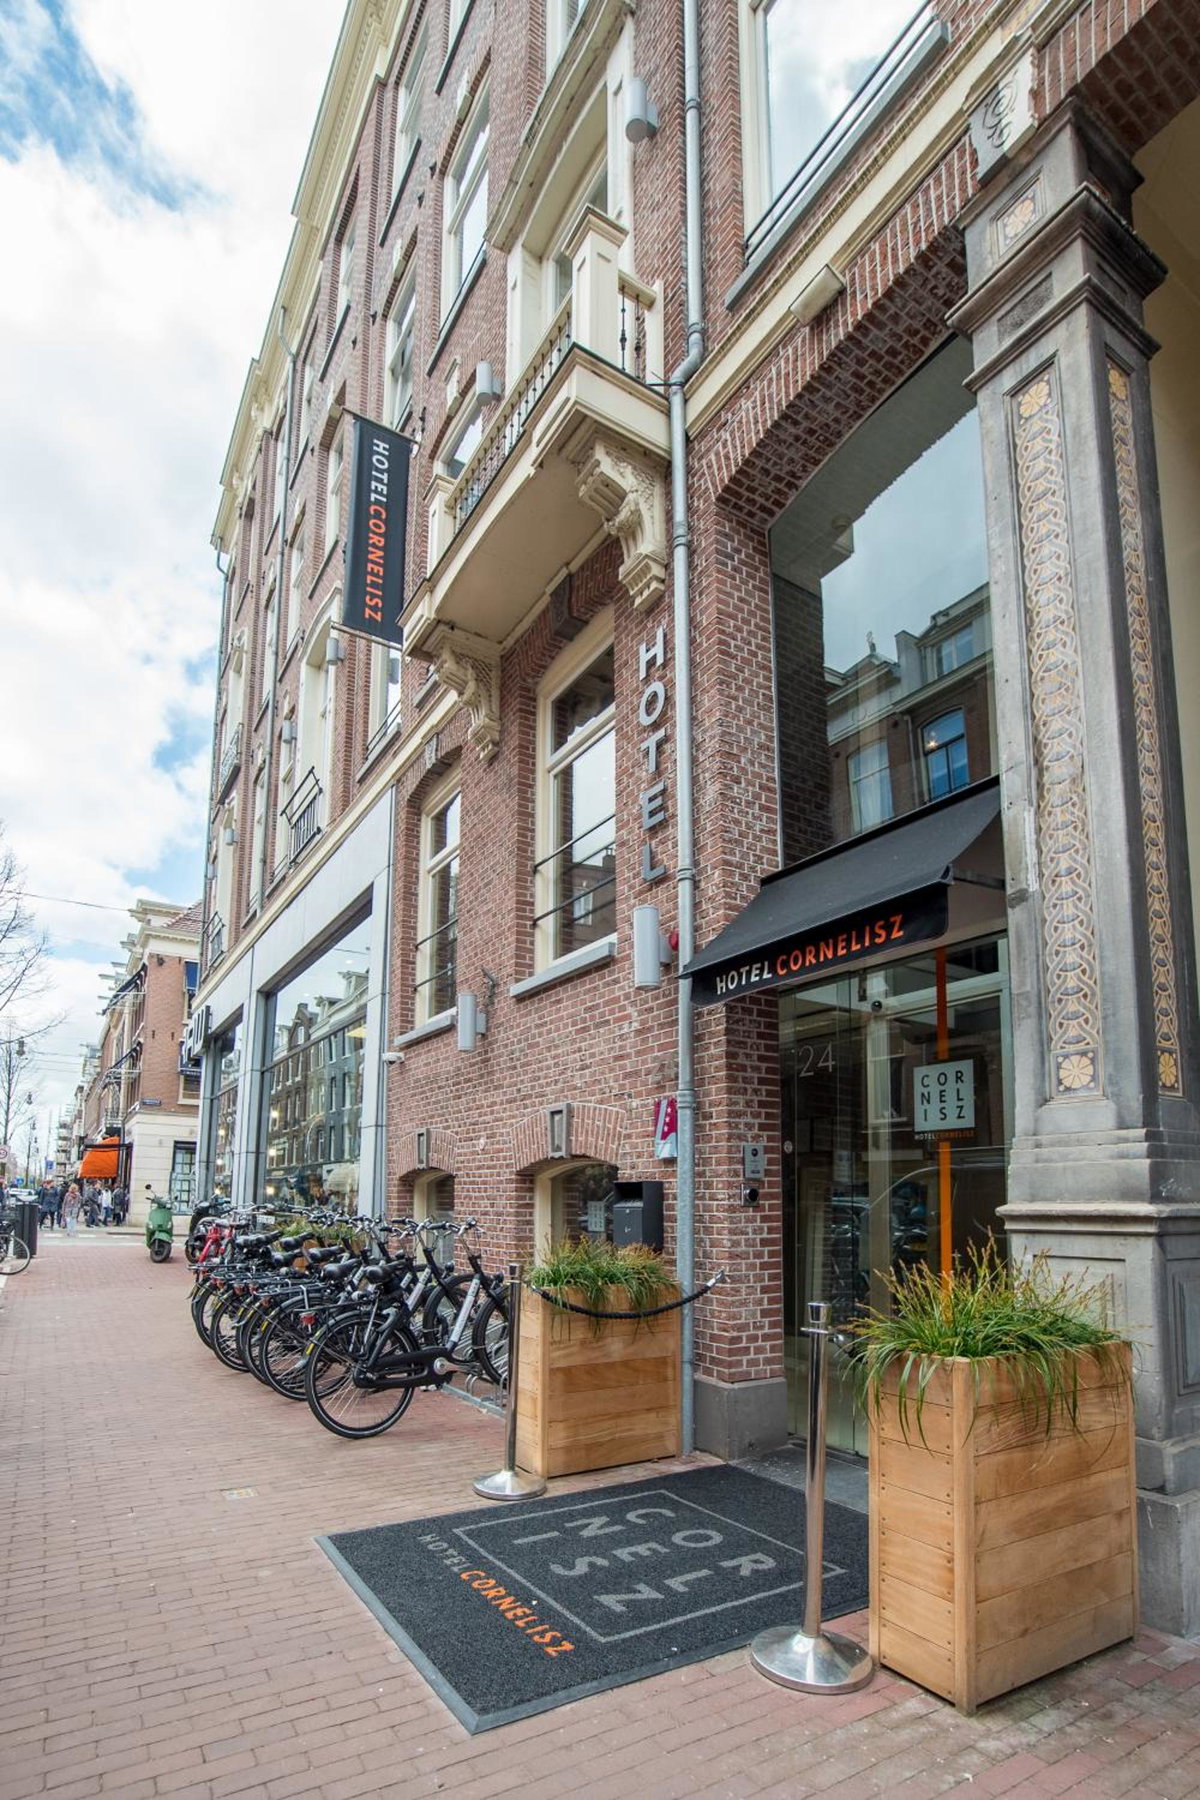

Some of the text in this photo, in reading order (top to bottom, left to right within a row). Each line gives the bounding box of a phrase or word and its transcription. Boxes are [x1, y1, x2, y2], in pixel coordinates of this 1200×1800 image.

[639, 626, 666, 883] HOTEL
[776, 913, 905, 977] CORNELISZ
[798, 1040, 836, 1077] 24
